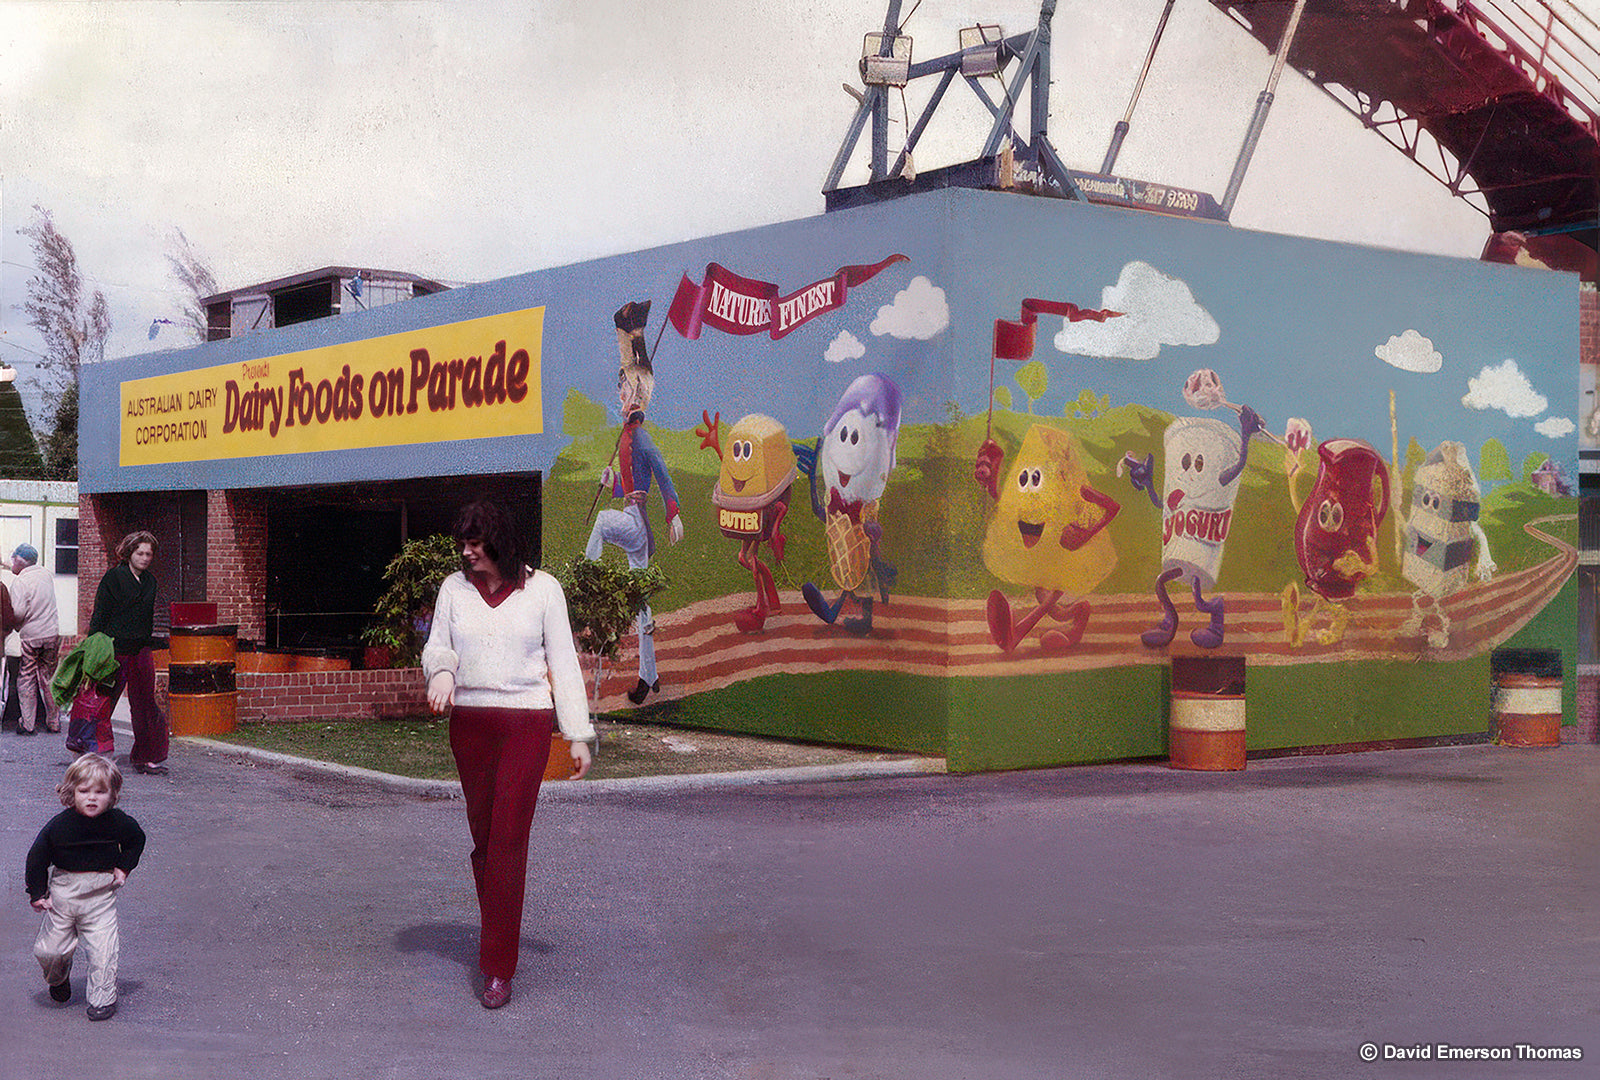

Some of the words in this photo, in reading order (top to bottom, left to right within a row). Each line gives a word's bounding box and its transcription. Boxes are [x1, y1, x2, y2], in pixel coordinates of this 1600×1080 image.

[778, 281, 836, 331] FINEST
[127, 392, 183, 417] AUSTRALIAN
[188, 387, 218, 410] DAIRY
[223, 379, 283, 438] Dairy
[286, 364, 364, 428] Foods
[369, 371, 405, 419] on
[406, 339, 531, 414] Parade
[136, 419, 207, 445] CORPORATION
[720, 509, 759, 530] BUTTER
[1163, 508, 1232, 546] YOGURT
